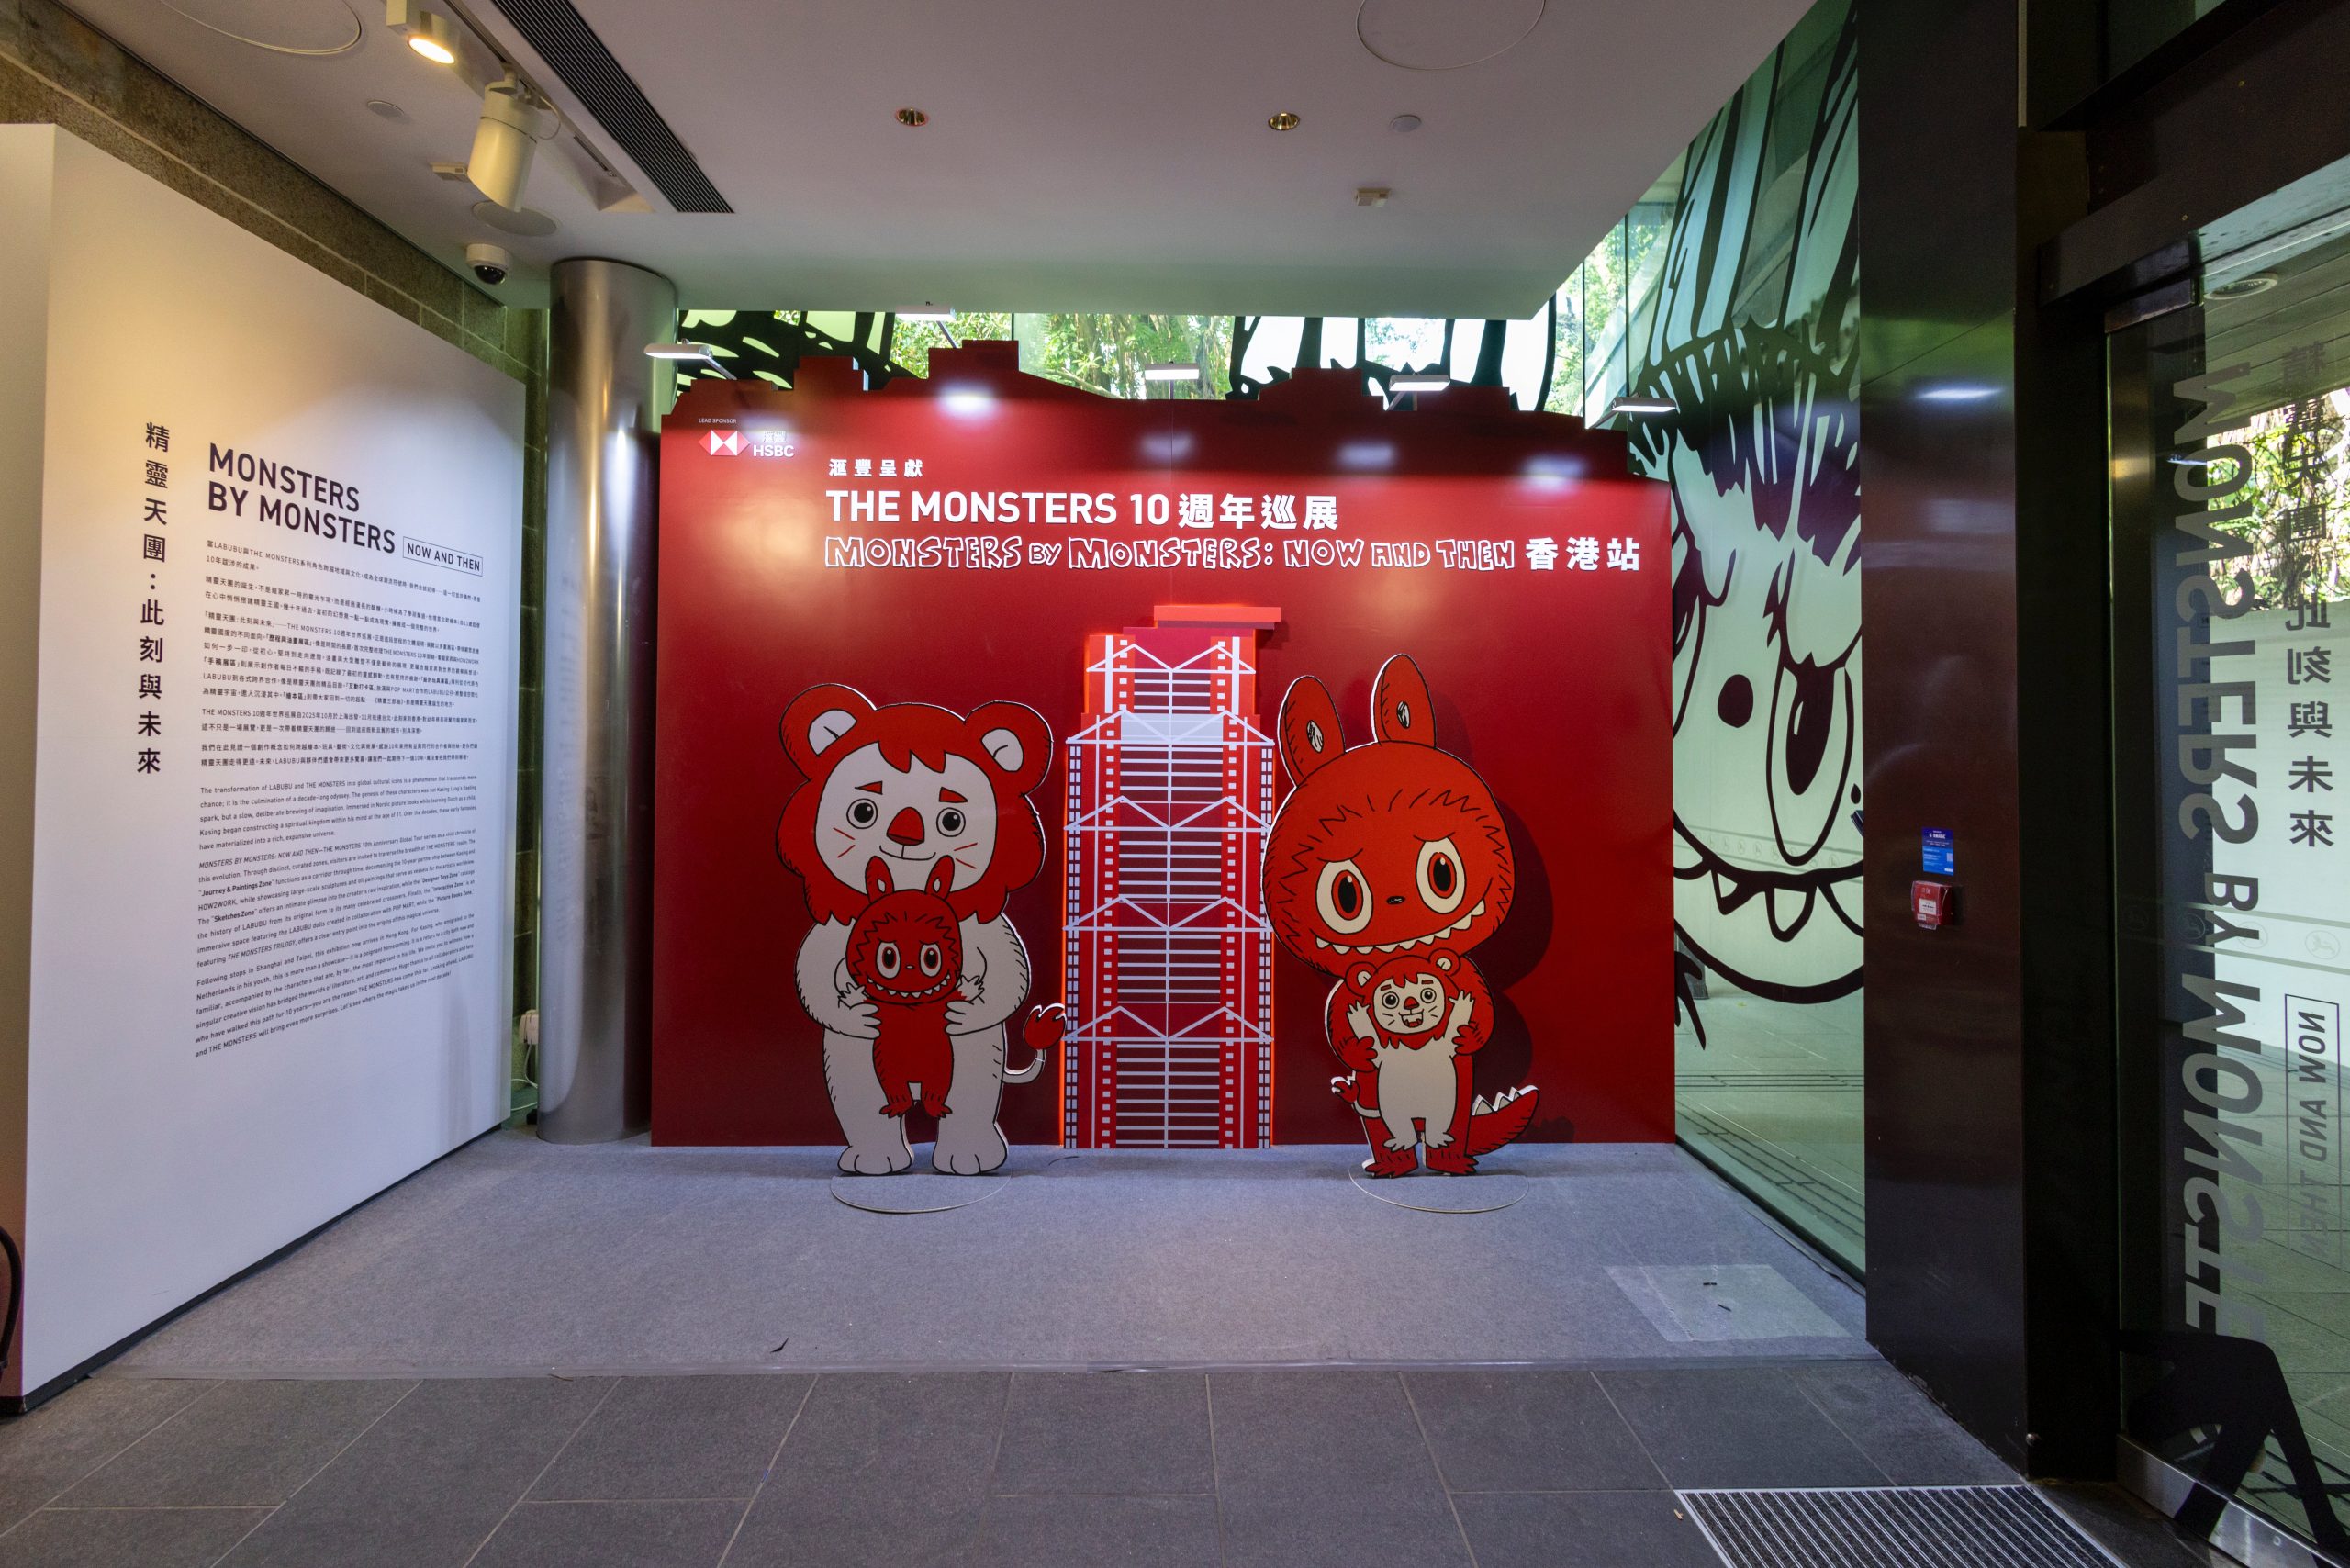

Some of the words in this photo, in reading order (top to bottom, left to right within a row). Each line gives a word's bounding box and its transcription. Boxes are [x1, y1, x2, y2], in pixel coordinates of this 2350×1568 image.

[753, 444, 795, 457] HSBC
[208, 442, 360, 513] MONSTERS
[207, 480, 249, 517] BY
[259, 494, 396, 554] MONSTERS
[826, 489, 900, 522] THE
[912, 491, 1117, 524] MONSTERS
[408, 543, 432, 566] NOW
[434, 550, 454, 570] AND
[456, 554, 481, 572] THEN
[824, 535, 1022, 569] MONSTERS
[1028, 543, 1062, 566] BY
[1069, 536, 1273, 570] MONSTERS:
[1284, 538, 1365, 569] NOW
[1370, 541, 1431, 568] AND
[1436, 540, 1515, 571] THEN
[1525, 536, 1640, 571] 香港站
[300, 625, 331, 634] MONSTERS
[242, 823, 278, 832] constructing
[216, 838, 253, 847] materialized
[198, 858, 232, 868] MONSTERS
[243, 853, 274, 862] MONSTERS:
[212, 872, 240, 880] evolution.
[243, 868, 267, 876] Through
[231, 883, 258, 891] Paintings
[275, 876, 300, 884] functions
[197, 899, 237, 911] HOW2WORK,
[257, 890, 289, 901] showcasing
[210, 928, 231, 936] history
[242, 920, 266, 930] LABUBU
[197, 942, 230, 953] immersive
[232, 937, 249, 946] space
[251, 932, 277, 941] featuring
[196, 957, 226, 968] featuring
[241, 945, 272, 958] MONSTERS
[196, 974, 227, 986] Following
[229, 969, 246, 978] stops
[256, 961, 282, 971] Shanghai
[284, 957, 294, 965] and
[196, 985, 235, 1001] Netherlands
[253, 976, 271, 986] youth,
[196, 1003, 222, 1014] familiar,
[225, 991, 263, 1006] accompanied
[196, 1016, 221, 1029] singular
[223, 1010, 247, 1021] creative
[249, 1004, 265, 1013] vision
[277, 994, 297, 1005] bridged
[195, 1035, 208, 1043] who
[210, 1030, 225, 1038] have
[226, 1022, 248, 1033] walked
[262, 1014, 274, 1024] path
[195, 1047, 207, 1058] and
[208, 1043, 221, 1052] THE
[223, 1032, 257, 1047] MONSTERS
[258, 1028, 269, 1036] will
[270, 1025, 285, 1033] bring
[285, 1020, 298, 1028] even
